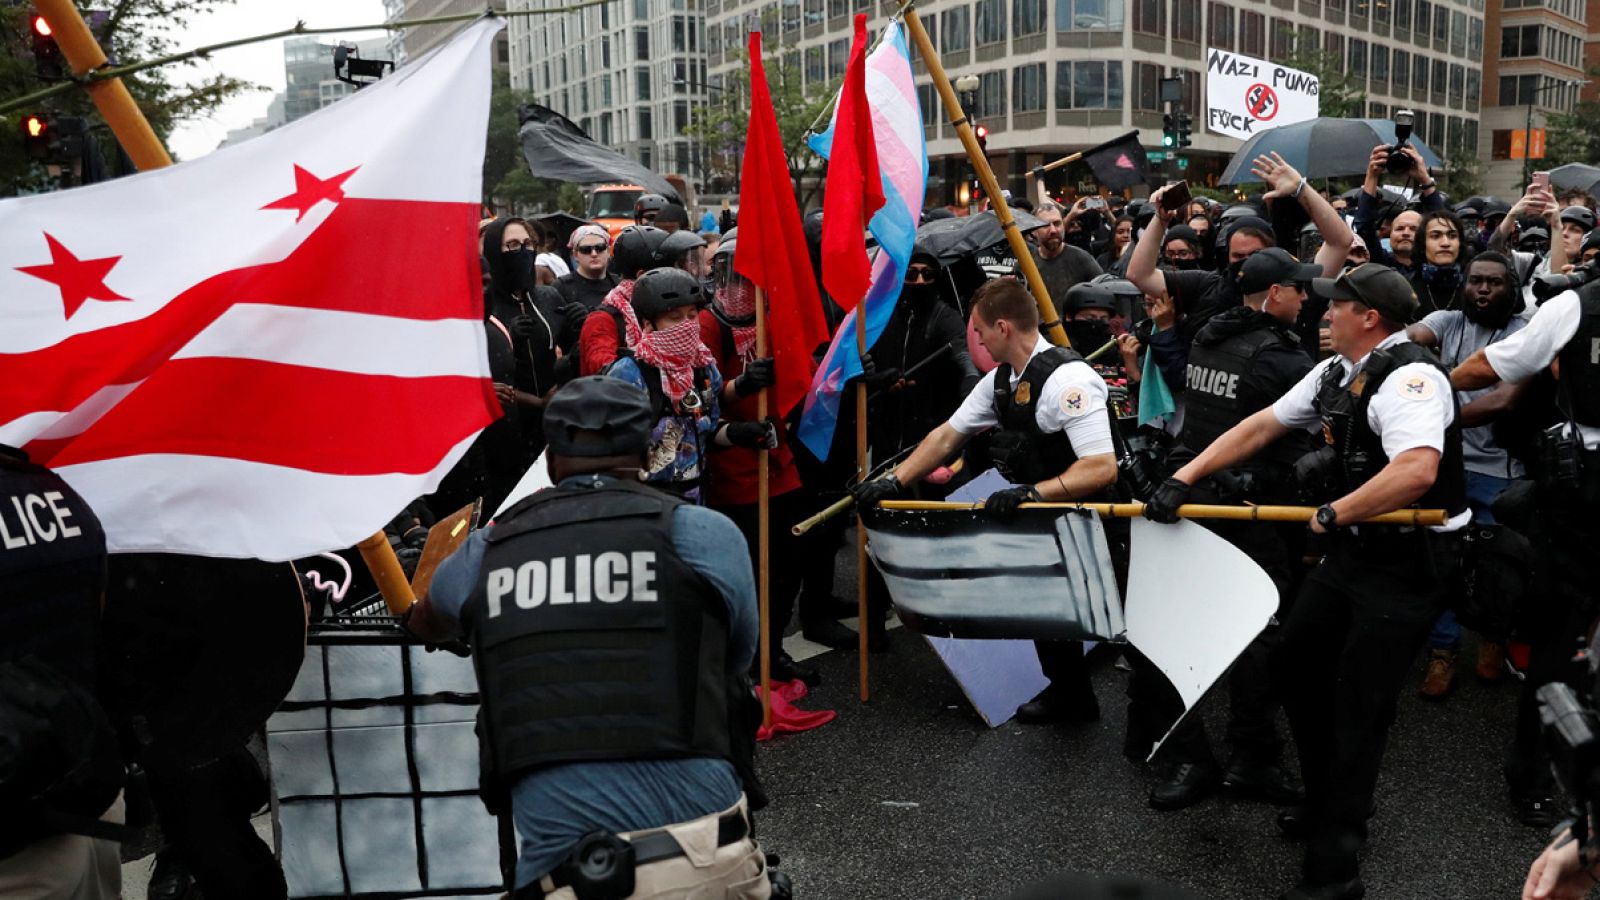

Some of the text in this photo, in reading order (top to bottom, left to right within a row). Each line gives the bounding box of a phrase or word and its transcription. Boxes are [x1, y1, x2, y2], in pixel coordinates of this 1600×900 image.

[1207, 50, 1318, 97] NAZI PUNKS
[1186, 363, 1240, 399] POLICE
[0, 491, 82, 550] LICE
[486, 551, 659, 619] POLICE
